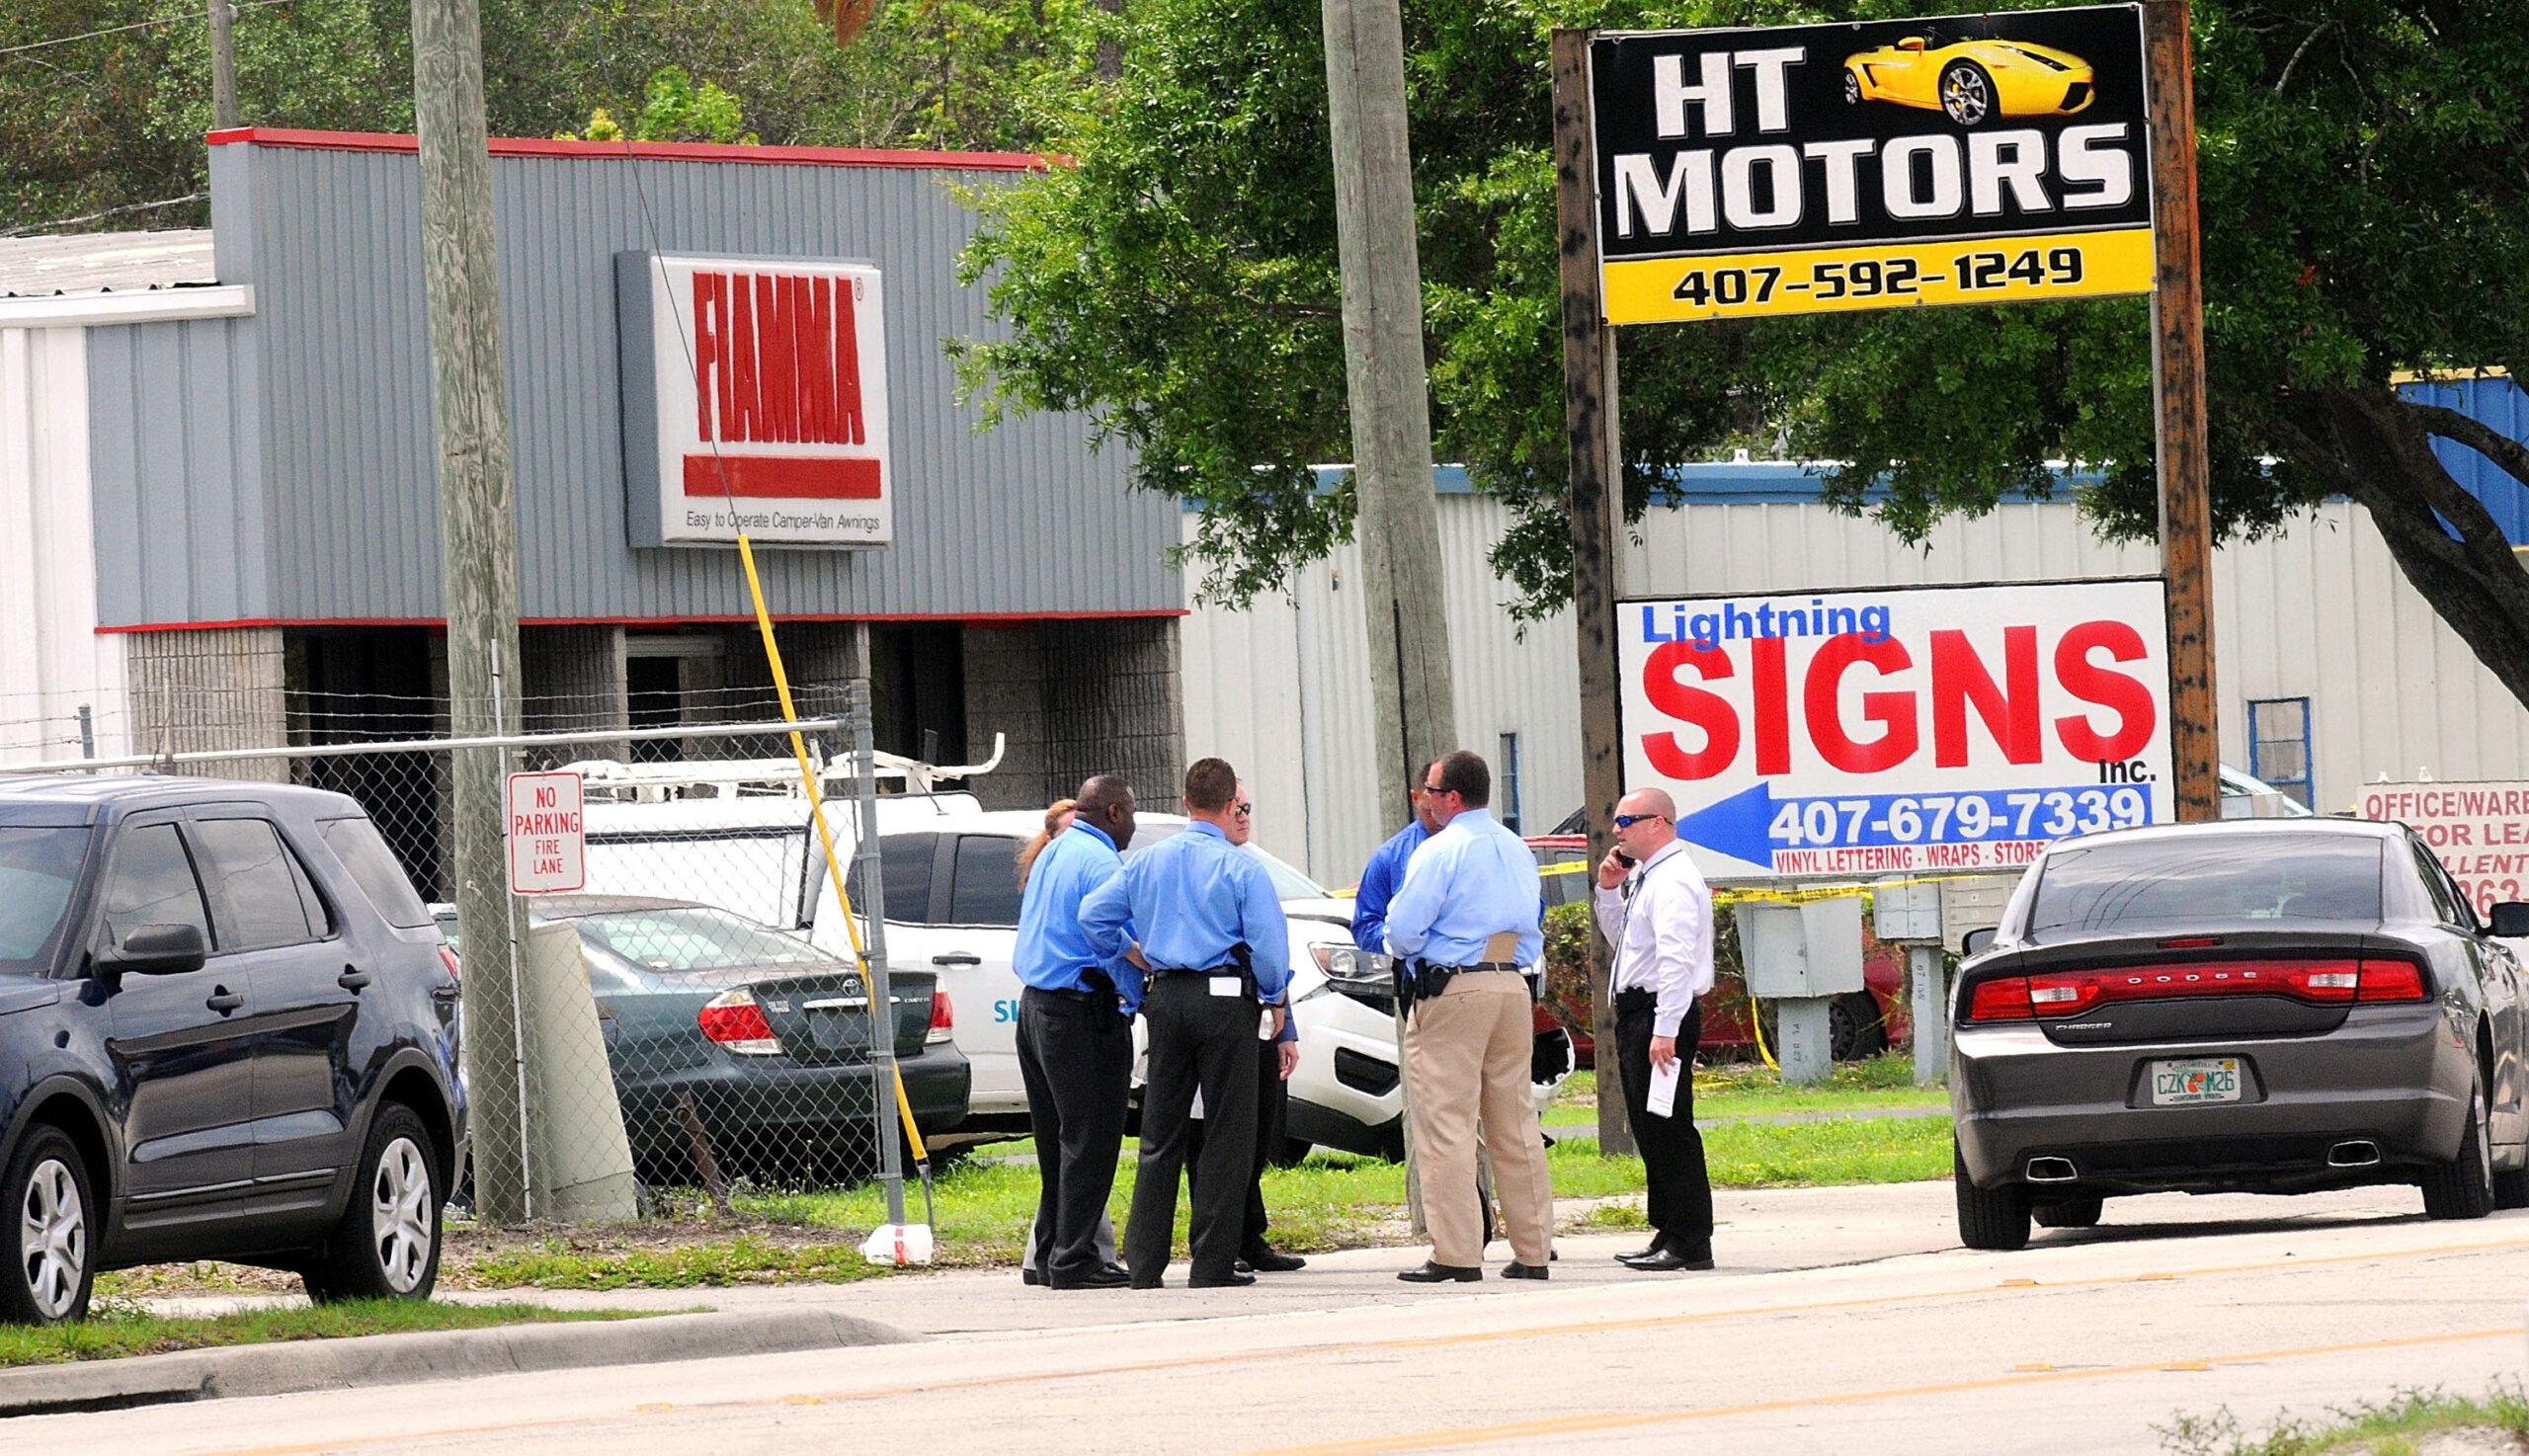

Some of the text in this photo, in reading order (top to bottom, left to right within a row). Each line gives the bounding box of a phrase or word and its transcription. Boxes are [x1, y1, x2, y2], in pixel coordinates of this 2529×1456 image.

[1654, 46, 1807, 139] HT
[1613, 121, 2134, 239] MOTORS
[1673, 247, 2083, 307] 407-592-1249
[692, 271, 865, 445] FIAMMA
[687, 511, 880, 534] Easy to Operate Camper-Van Awnings
[1642, 599, 1891, 652] Lightning
[1640, 619, 2157, 781] SIGNS
[536, 786, 556, 808] NO
[1768, 788, 2145, 846] 407-679-7339
[515, 812, 579, 836] PARKING
[533, 858, 564, 875] LANE
[535, 839, 560, 854] FIRE
[1776, 849, 1823, 873] VINYL
[1828, 847, 1913, 872] LETTERING
[1926, 844, 1980, 866] WRAPS
[2157, 1071, 2235, 1094] CZK M26
